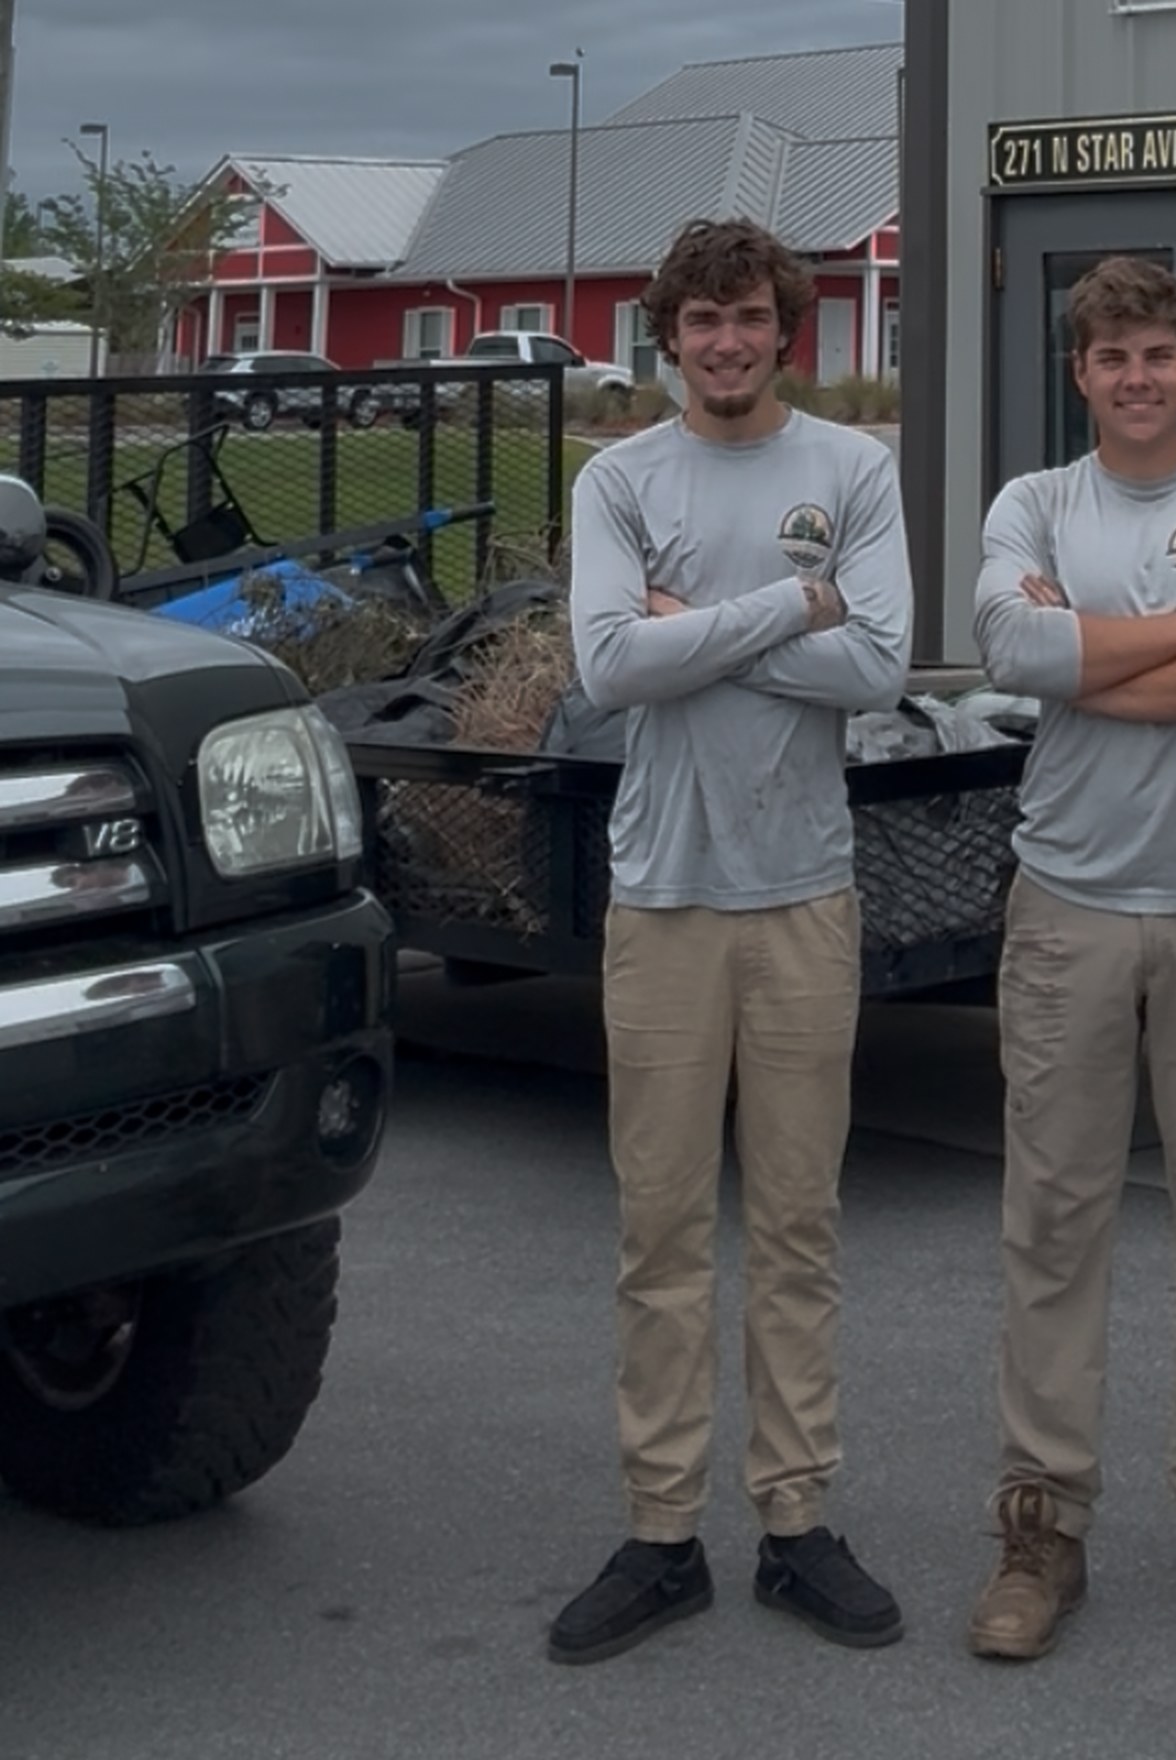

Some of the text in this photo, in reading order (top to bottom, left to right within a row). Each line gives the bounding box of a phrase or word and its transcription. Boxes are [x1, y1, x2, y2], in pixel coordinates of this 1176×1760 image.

[1003, 139, 1042, 176] 271
[1053, 136, 1069, 174] N
[1077, 131, 1134, 173] STAR
[82, 817, 140, 858] V8
